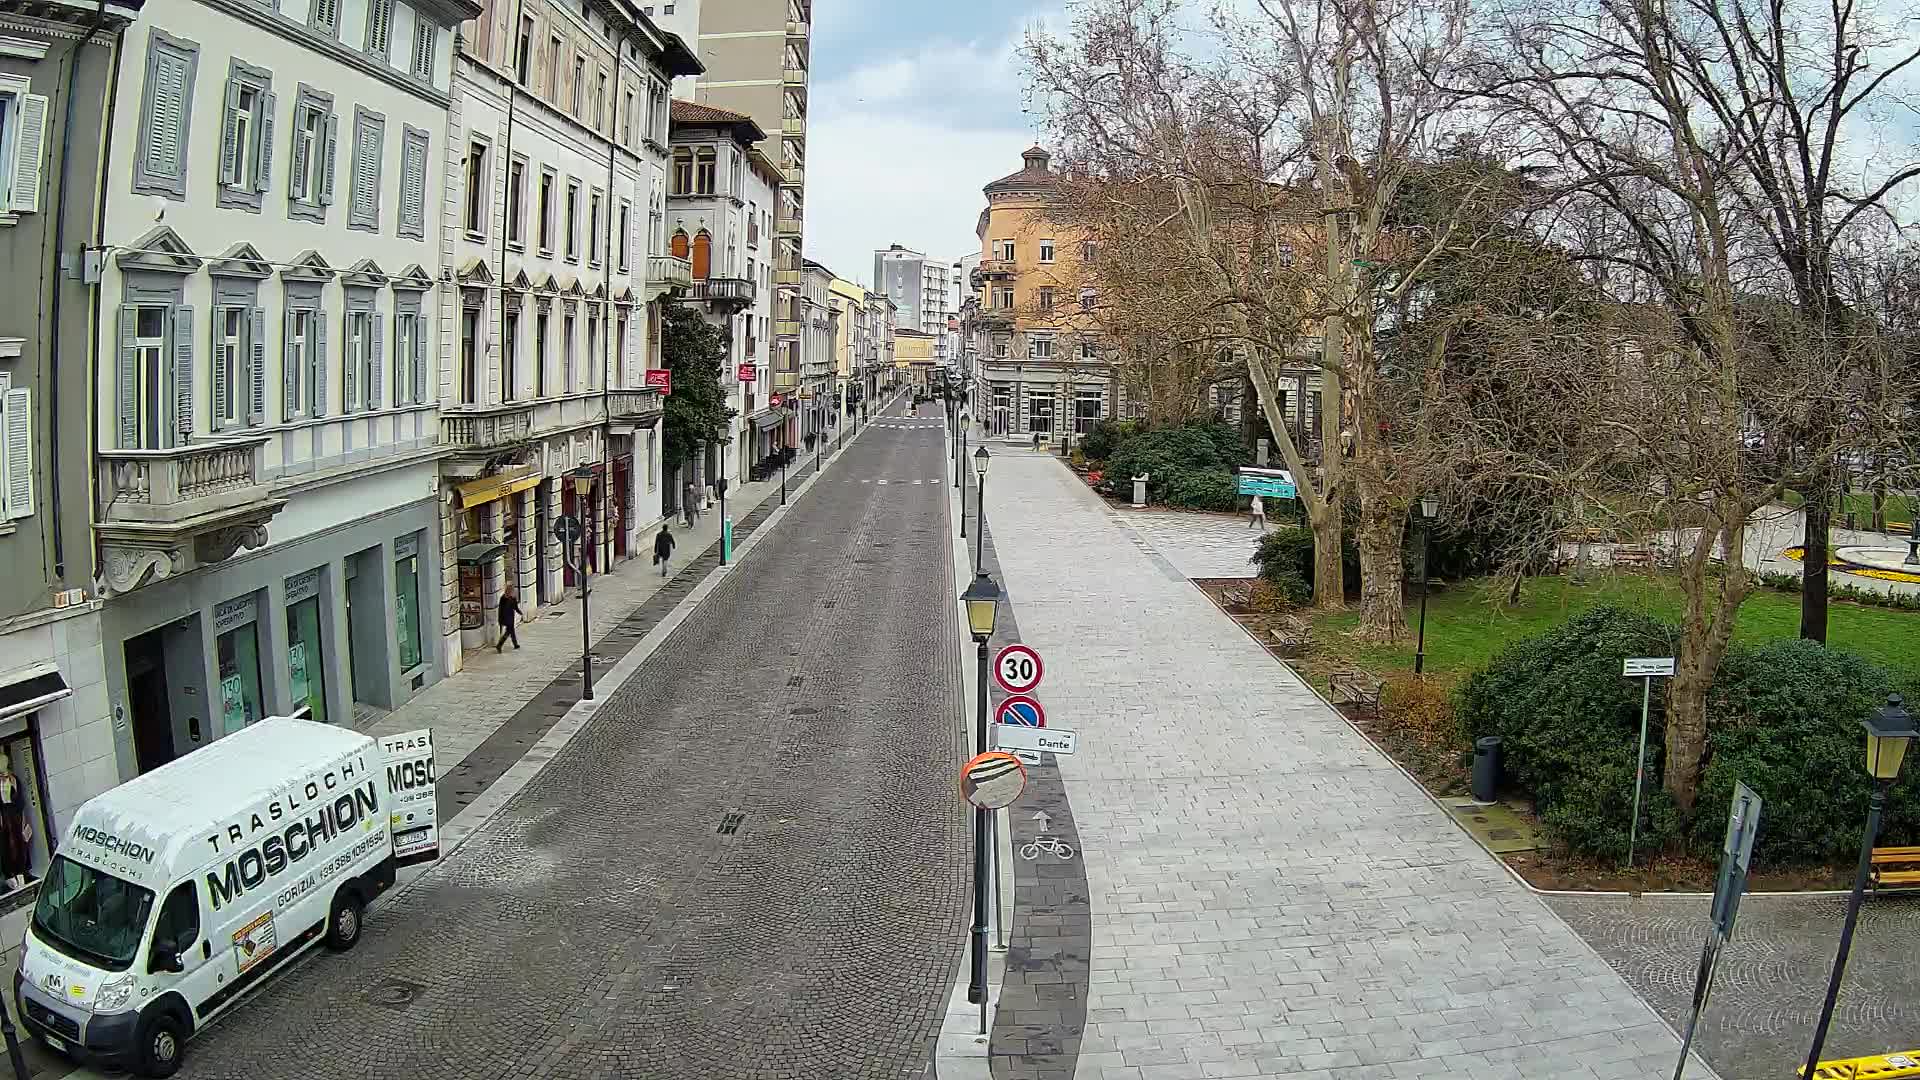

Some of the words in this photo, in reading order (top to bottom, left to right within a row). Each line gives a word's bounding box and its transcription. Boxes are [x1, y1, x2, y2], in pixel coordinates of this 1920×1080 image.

[1005, 658, 1032, 680] 30
[222, 677, 240, 700] 130
[1038, 738, 1070, 749] Dante
[207, 757, 365, 853] TRASLOCHI
[73, 824, 155, 865] MOSCHION
[206, 780, 379, 911] MOSCHION
[277, 872, 316, 908] GORIZIA
